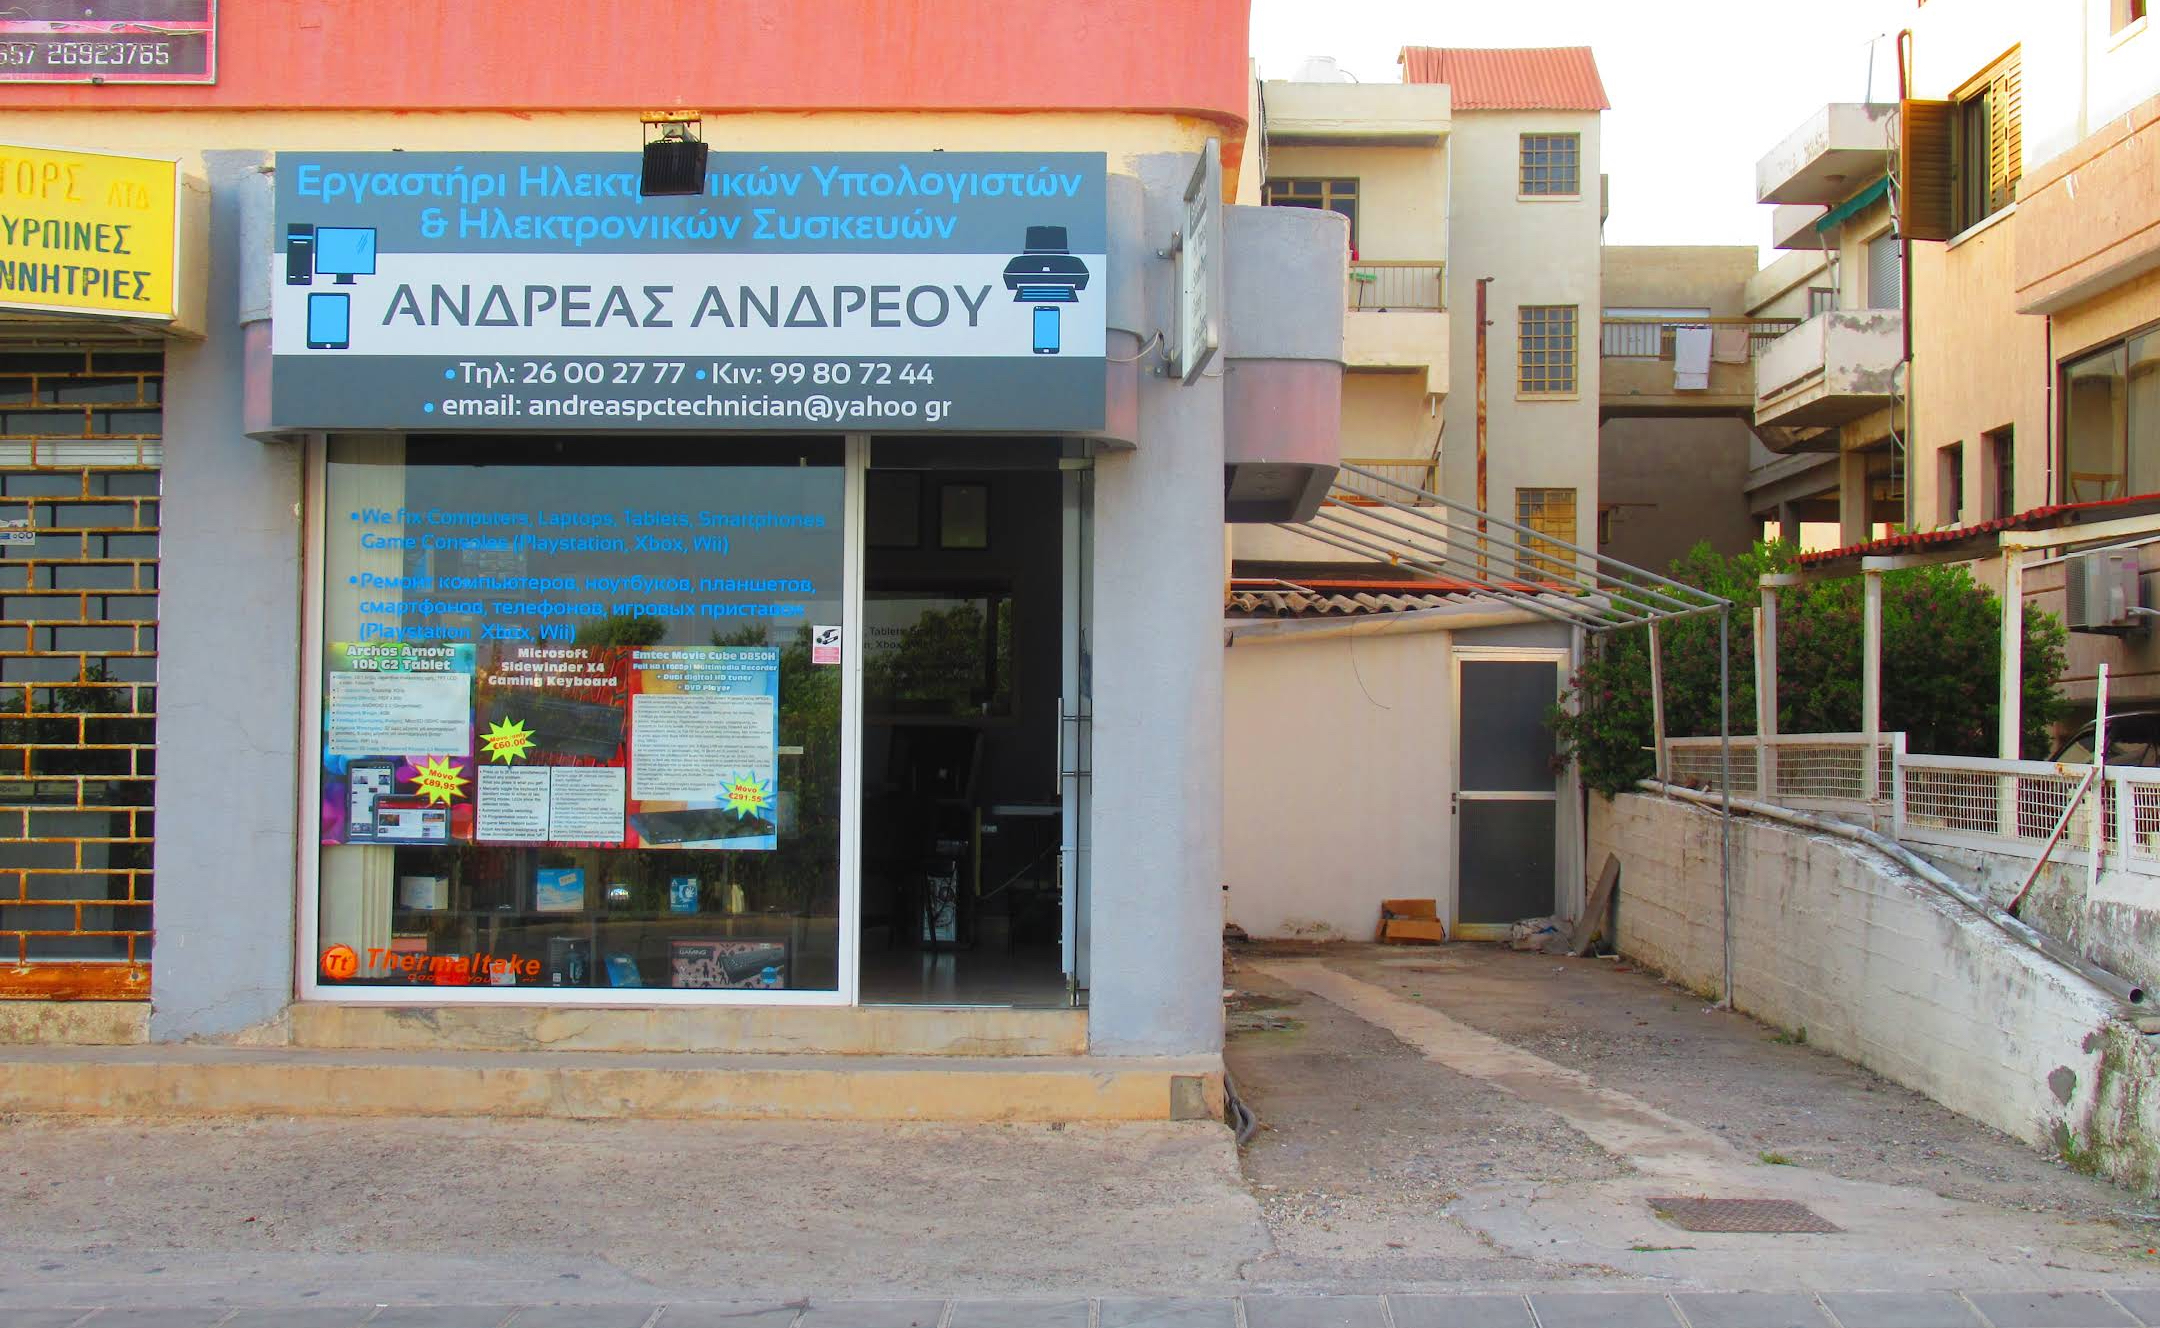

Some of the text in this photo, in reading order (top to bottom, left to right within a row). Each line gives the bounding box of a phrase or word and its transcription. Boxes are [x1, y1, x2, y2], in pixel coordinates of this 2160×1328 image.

[48, 42, 169, 65] 26923765
[297, 164, 506, 204] Εργαστήρι
[811, 164, 1082, 204] Υπολογιστών
[421, 207, 958, 247] & Ηλεκτρονικών Συσκευών
[382, 284, 993, 329] ΑΝΔΡΕΑΣ ΑΝΔΡΕΟΥ
[460, 362, 934, 389] Τηλ: 26 00 27 77 Κιν: 99 80 72 44
[442, 394, 522, 416] email:
[361, 509, 393, 525] We
[427, 508, 534, 528] Computers,
[539, 510, 617, 530] Laptops,
[624, 509, 693, 529] Tablets,
[699, 511, 826, 531] Smartphones
[361, 533, 729, 556] Game Consoles (Playstation, Xbox, Wii)
[361, 573, 816, 595] Ремонт компьютеров, ноутбуков, планшетов,
[360, 599, 487, 617] смартфонов,
[493, 600, 607, 619] телефонов,
[613, 602, 695, 619] игровых
[481, 623, 535, 643] Xbox,
[540, 624, 577, 644] Wii)
[347, 646, 456, 657] Archos Arnova
[517, 648, 589, 659] Microsoft
[632, 650, 670, 660] Emtec
[671, 651, 706, 660] Movie
[708, 651, 738, 661] Cube
[352, 659, 451, 671] 10b G2 Tablet
[587, 662, 606, 673] X4
[693, 663, 740, 671] Multimedia
[488, 675, 618, 688] Gaming Keyboard
[367, 948, 541, 976] Thermaltake
